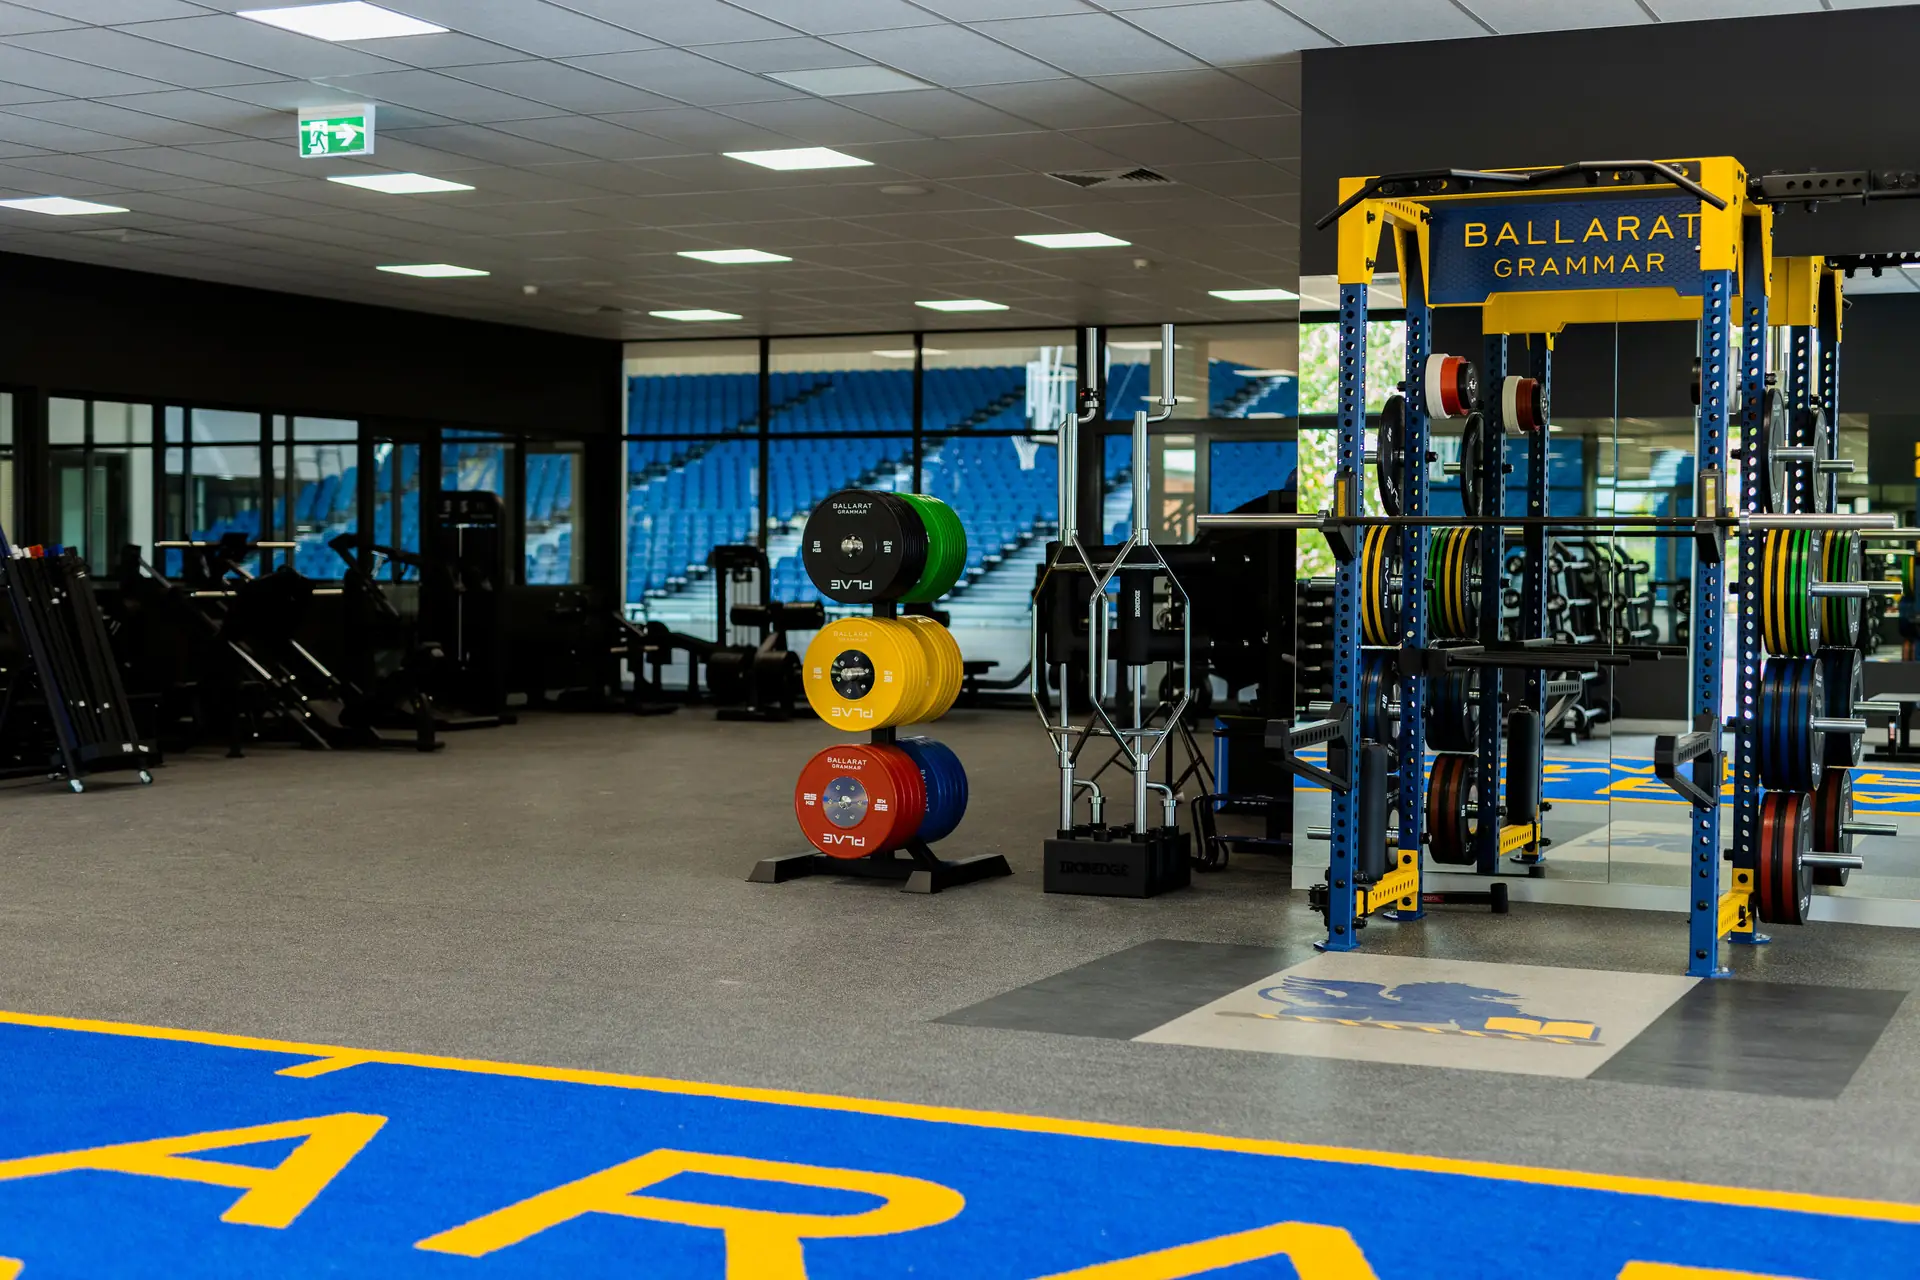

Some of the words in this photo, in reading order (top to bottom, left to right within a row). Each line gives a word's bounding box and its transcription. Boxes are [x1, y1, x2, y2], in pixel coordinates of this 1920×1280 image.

[1464, 213, 1701, 248] BALLARAT
[1494, 253, 1665, 278] GRAMMAR
[813, 540, 821, 548] 5
[827, 756, 867, 765] BALLARAT
[803, 792, 817, 801] 25
[874, 803, 888, 812] 25
